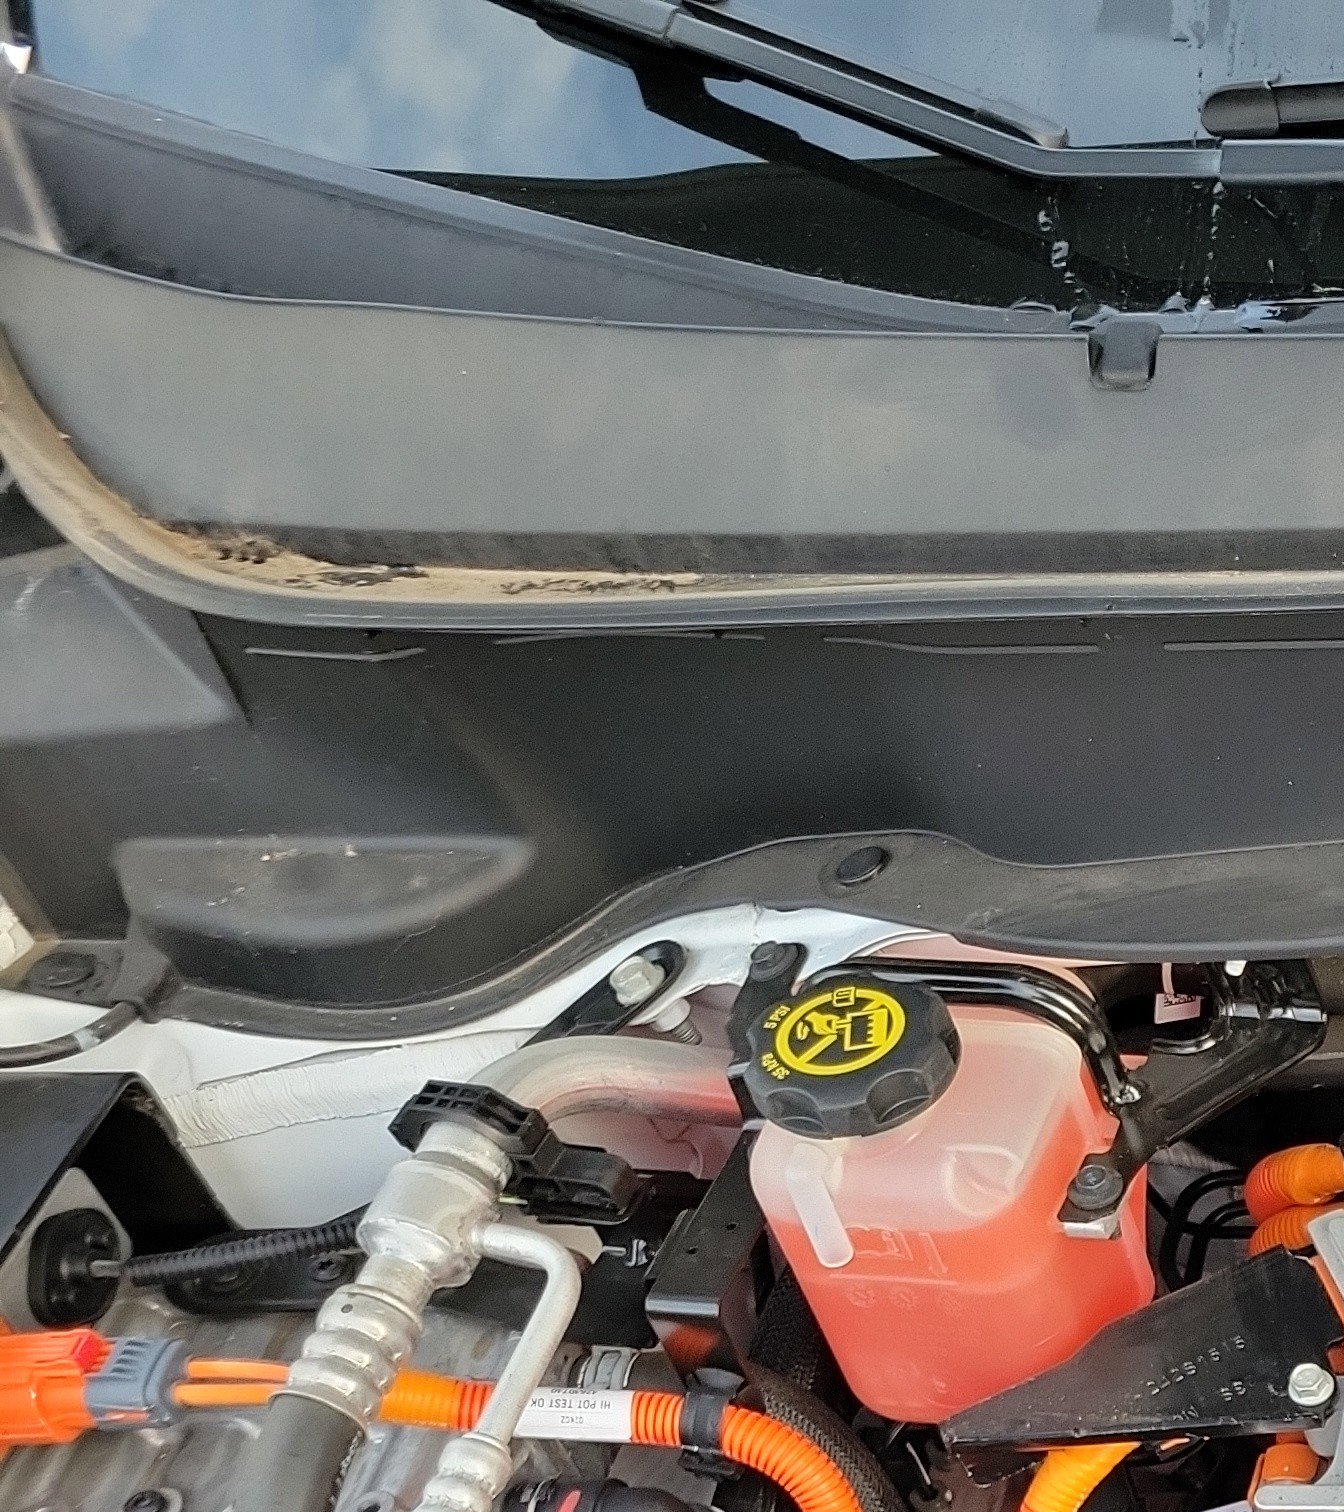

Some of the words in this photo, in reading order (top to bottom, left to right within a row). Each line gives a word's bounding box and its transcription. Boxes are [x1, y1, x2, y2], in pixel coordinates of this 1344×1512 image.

[530, 1397, 544, 1407] OK
[548, 1398, 572, 1408] TEST
[577, 1399, 595, 1409] POT
[600, 1400, 610, 1409] HI
